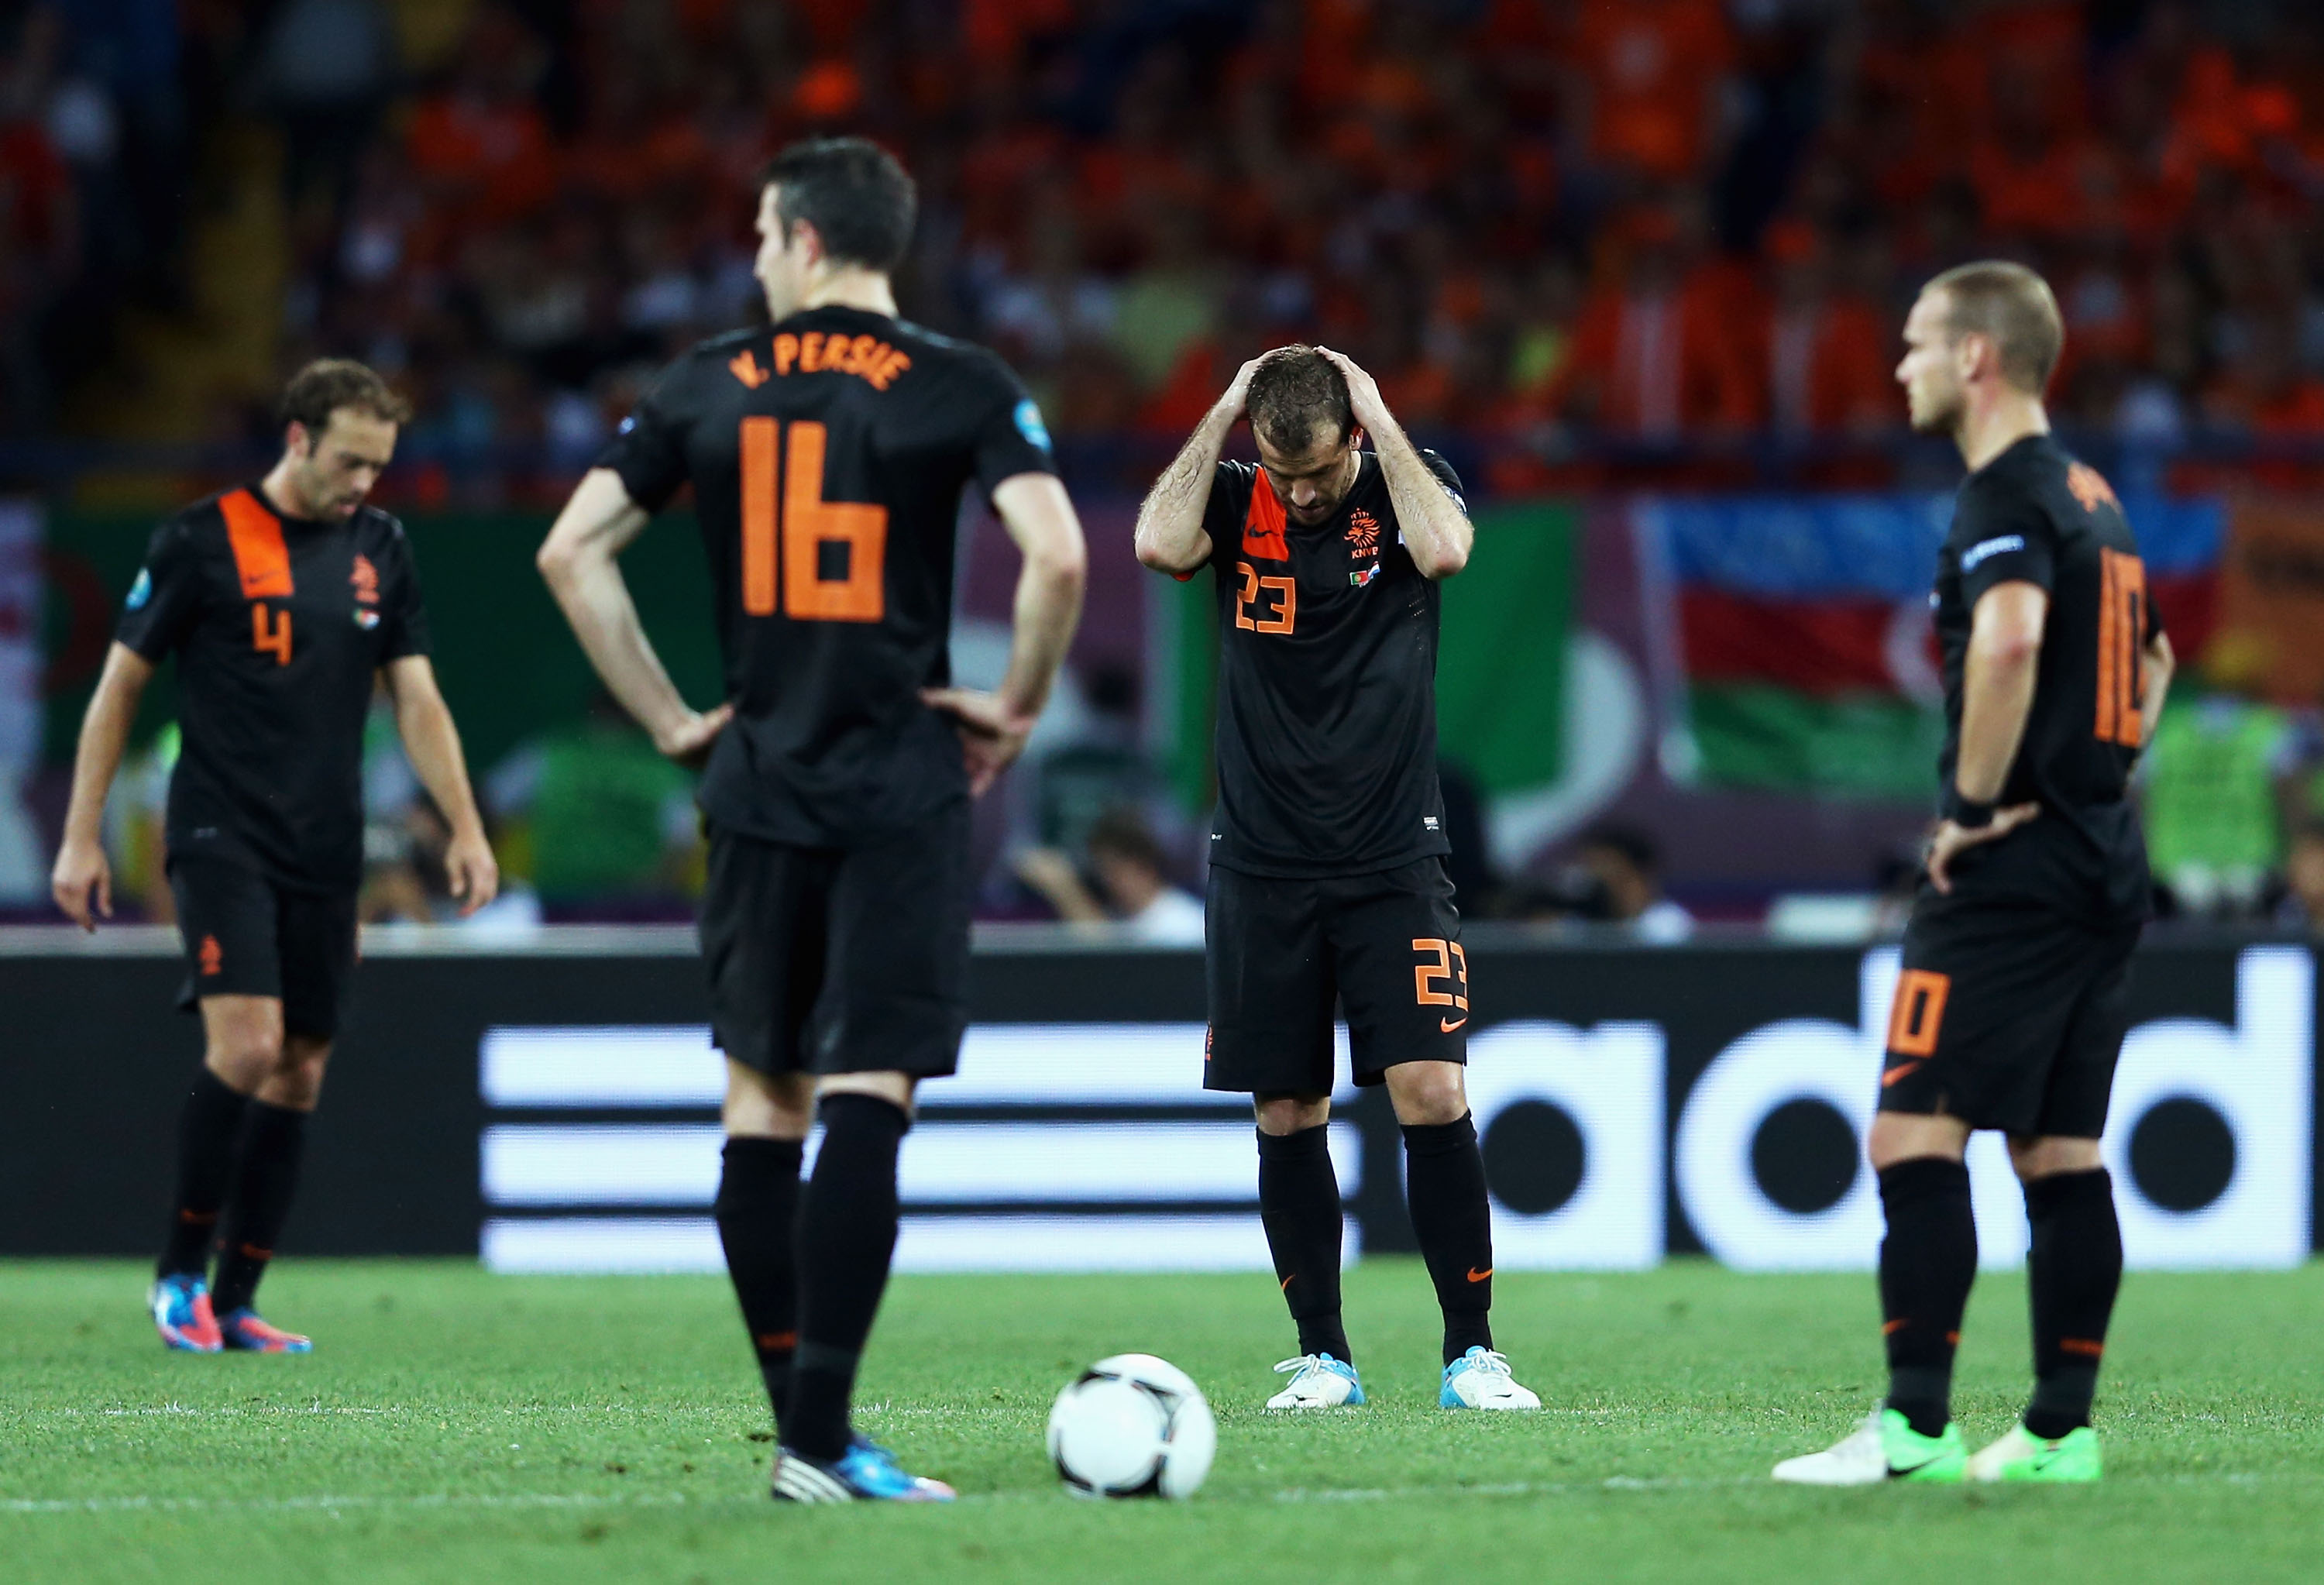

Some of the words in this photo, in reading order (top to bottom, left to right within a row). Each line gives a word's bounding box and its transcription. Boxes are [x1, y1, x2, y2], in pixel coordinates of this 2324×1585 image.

[772, 332, 912, 391] PERSIE
[740, 416, 889, 622] 16
[252, 602, 292, 666] 4
[1236, 561, 1296, 634] 23
[2095, 545, 2148, 748] 10
[1412, 938, 1469, 1012] 23
